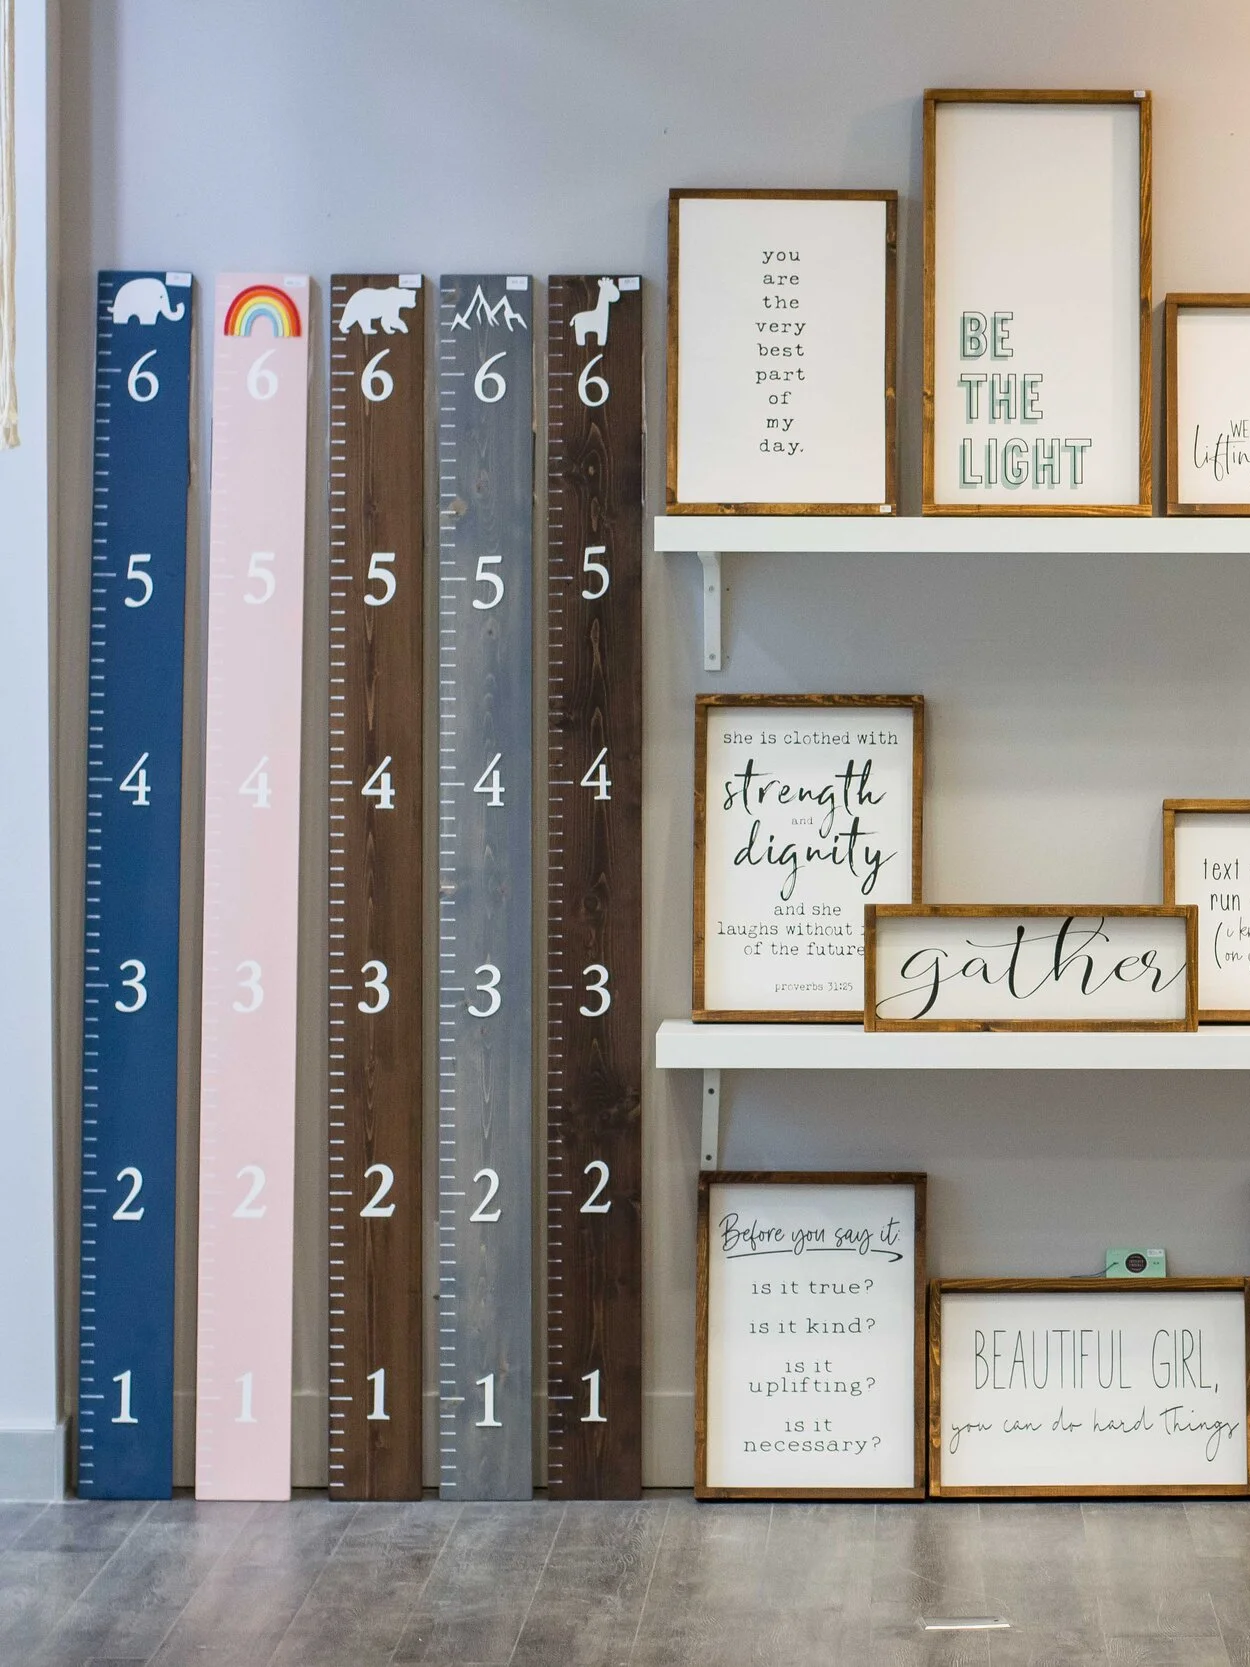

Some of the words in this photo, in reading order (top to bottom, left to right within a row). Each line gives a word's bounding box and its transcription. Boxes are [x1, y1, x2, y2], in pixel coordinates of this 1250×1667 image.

[762, 251, 800, 264] you
[763, 275, 799, 285] are
[763, 296, 799, 309] the
[755, 323, 806, 336] very
[757, 343, 804, 357] best
[958, 309, 1016, 362] BE
[128, 349, 159, 402] 6
[246, 348, 279, 400] 6
[361, 349, 395, 402] 6
[473, 352, 507, 403] 6
[578, 353, 610, 406] 6
[756, 368, 805, 384] part
[769, 391, 791, 404] of
[958, 372, 1045, 426] THE
[760, 439, 803, 455] day.
[767, 419, 794, 432] my
[1230, 420, 1248, 438] WE
[958, 436, 1094, 491] LIGHT
[125, 553, 153, 608] 5
[243, 552, 277, 605] 5
[364, 553, 396, 607] 5
[471, 555, 505, 610] 5
[582, 545, 610, 600] 5
[724, 732, 752, 744] she
[761, 731, 776, 744] is
[784, 731, 850, 745] clothed
[857, 731, 898, 745] with
[119, 752, 151, 806] 4
[238, 756, 272, 808] 4
[361, 755, 395, 809] 4
[473, 753, 505, 807] 4
[580, 747, 612, 800] 4
[723, 758, 887, 839] strength
[792, 817, 813, 825] and
[733, 816, 899, 901] dignity
[1204, 858, 1238, 880] text
[774, 903, 805, 916] and
[812, 903, 841, 916] she
[1211, 894, 1240, 911] run
[717, 921, 778, 938] laughs
[786, 923, 852, 936] without
[744, 941, 762, 955] of
[771, 942, 798, 955] the
[806, 942, 865, 956] future
[875, 916, 1188, 1021] gather
[1225, 951, 1243, 962] on
[115, 959, 147, 1012] 3
[232, 960, 265, 1014] 3
[357, 959, 391, 1014] 3
[467, 964, 502, 1019] 3
[579, 964, 611, 1018] 3
[775, 982, 823, 992] proverbs
[828, 982, 853, 991] 31:25
[113, 1166, 144, 1220] 2
[232, 1165, 267, 1219] 2
[359, 1163, 396, 1218] 2
[469, 1169, 501, 1223] 2
[579, 1160, 612, 1214] 2
[718, 1212, 785, 1252] Before
[791, 1226, 825, 1256] you
[834, 1226, 873, 1256] say
[751, 1280, 772, 1295] is
[781, 1281, 798, 1294] it
[809, 1279, 873, 1294] true?
[748, 1317, 773, 1335] is
[779, 1320, 796, 1333] it
[806, 1318, 875, 1333] kind?
[749, 1377, 875, 1397] uplifting?
[785, 1359, 809, 1374] is
[815, 1360, 832, 1373] it
[975, 1329, 1131, 1390] BEAUTIFUL
[1152, 1329, 1218, 1393] GIRL,
[111, 1370, 138, 1423] 1
[234, 1371, 258, 1423] 1
[366, 1368, 390, 1421] 1
[475, 1373, 502, 1428] 1
[580, 1369, 608, 1423] 1
[744, 1436, 881, 1455] necessary?
[785, 1417, 809, 1433] is
[814, 1419, 831, 1432] it
[949, 1422, 992, 1454] you
[1004, 1420, 1042, 1433] can
[1052, 1406, 1082, 1432] do
[1094, 1406, 1153, 1433] hard
[1160, 1405, 1240, 1463] things
